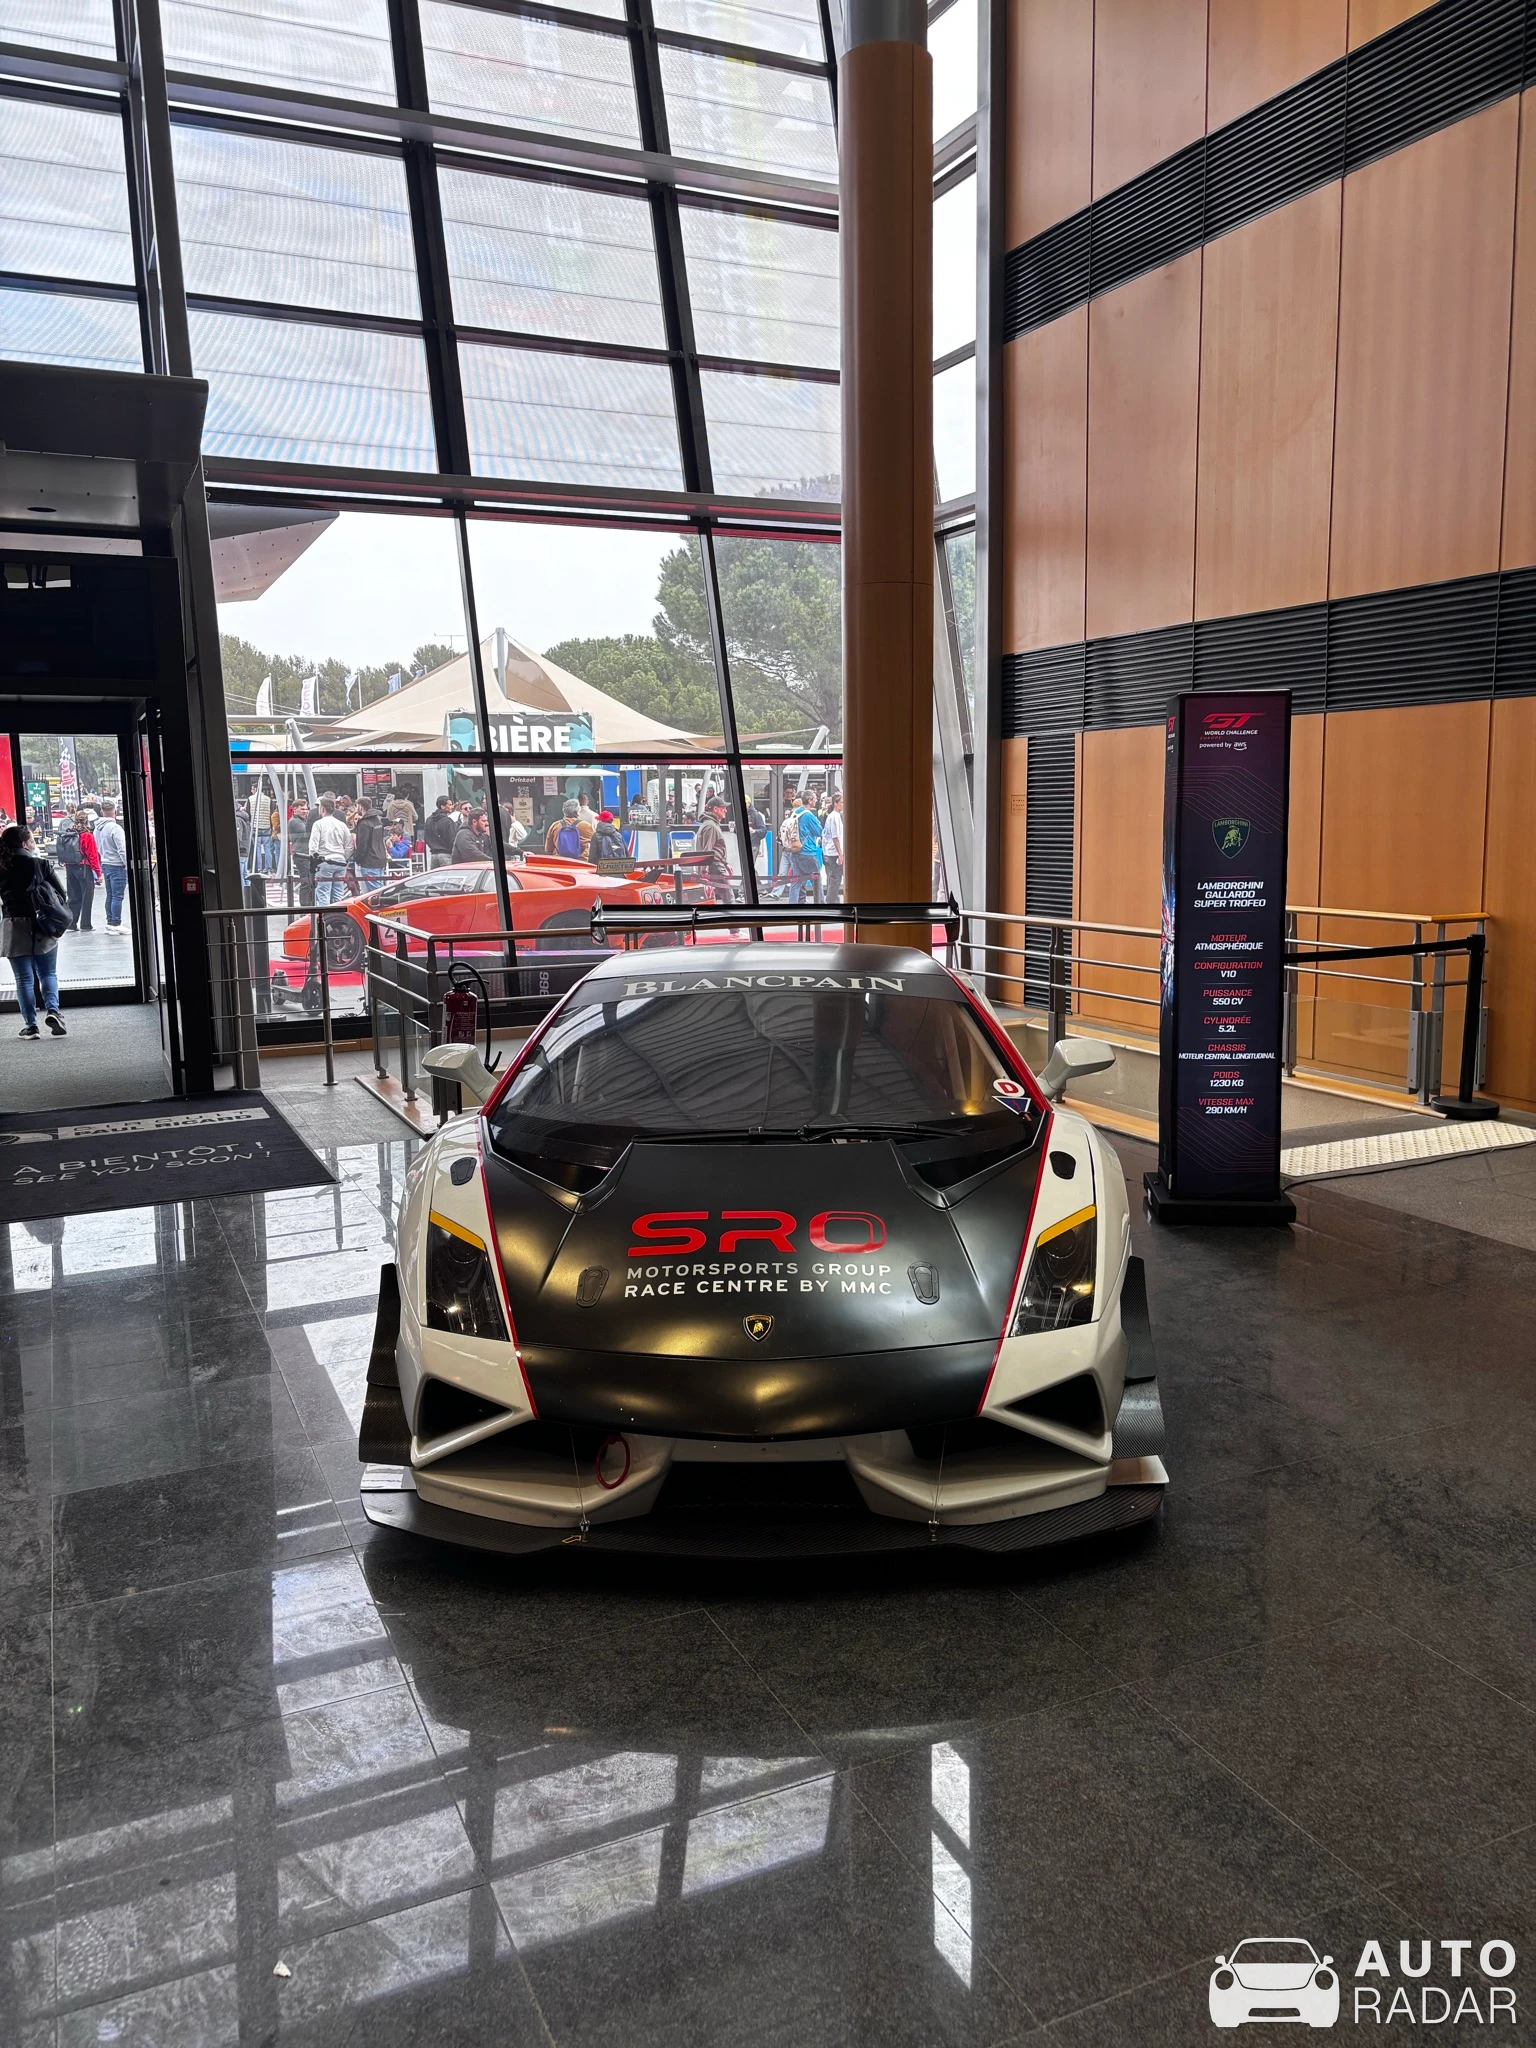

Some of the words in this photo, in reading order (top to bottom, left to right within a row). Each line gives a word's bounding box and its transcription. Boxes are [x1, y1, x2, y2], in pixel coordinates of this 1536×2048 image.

[1197, 881, 1264, 890] LAMBORGHINI
[1205, 890, 1256, 899] GALLARDO
[1194, 900, 1226, 908] SUPER
[1228, 899, 1266, 907] TROFEO
[1211, 934, 1247, 942] MOTEUR
[1194, 941, 1264, 951] ATMOSPHÉRIQUE
[1194, 962, 1263, 970] CONFIGURATION
[1221, 970, 1237, 978] V10
[621, 975, 906, 997] BLANCPAIN
[1203, 989, 1253, 997] PUISSANCE
[1203, 1015, 1251, 1024] CYLINDRÉE
[1218, 1025, 1237, 1033] 5.2L
[1207, 1044, 1246, 1052] CHASSIS
[1233, 1052, 1275, 1060] LONGITUDINAL
[1213, 1071, 1240, 1079] POIDS
[1209, 1079, 1231, 1087] 1230
[1231, 1079, 1244, 1087] KG
[1198, 1098, 1234, 1106] VITESSE
[1224, 1106, 1247, 1114] KM/H
[75, 1126, 144, 1136] PAUL
[155, 1114, 252, 1128] RICARD
[59, 1143, 239, 1171] BIENTÔT
[13, 1172, 79, 1185] SEE
[92, 1163, 154, 1176] YOU
[165, 1153, 252, 1168] SOON
[628, 1211, 887, 1256] SRO
[627, 1262, 799, 1279] MOTORSPORTS
[812, 1263, 891, 1277] GROUP
[624, 1282, 686, 1298] RACE
[697, 1280, 788, 1294] CENTRE
[800, 1280, 829, 1293] BY
[841, 1282, 892, 1295] MMC
